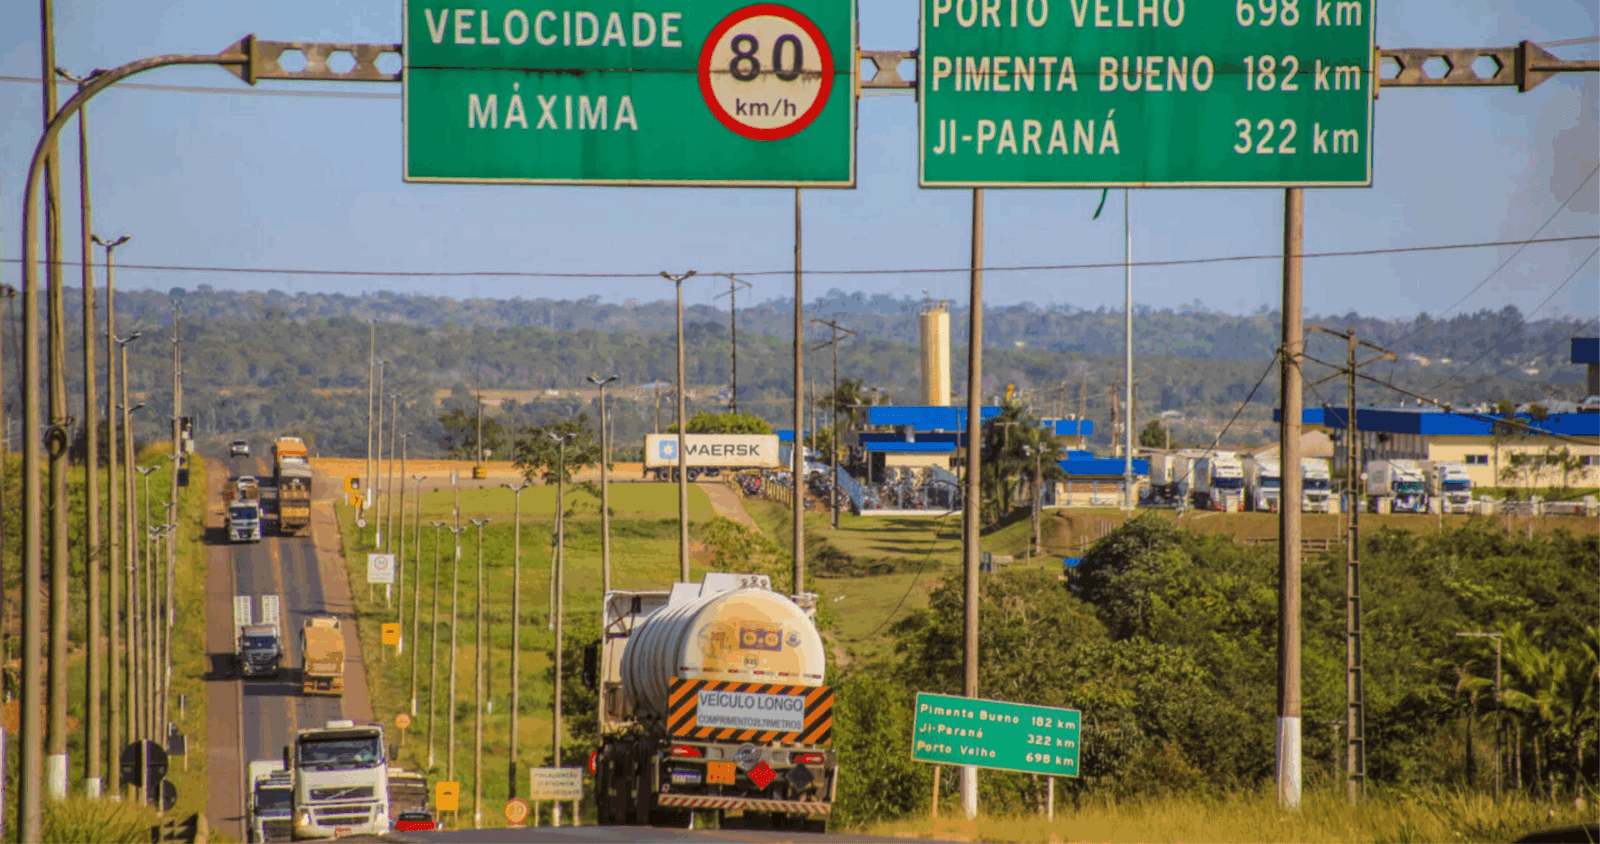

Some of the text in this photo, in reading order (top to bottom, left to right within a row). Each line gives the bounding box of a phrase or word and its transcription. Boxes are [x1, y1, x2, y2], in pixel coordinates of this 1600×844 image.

[932, 0, 1362, 28] PORTO VELHO 698 km
[424, 9, 682, 48] VELOCIDADE
[730, 33, 803, 82] 80
[932, 55, 1361, 92] PIMENTA BUENO 182 km
[468, 82, 639, 131] MÁXIMA
[735, 98, 797, 117] km/h
[932, 109, 1359, 155] JI-PARANÁ 322 km
[685, 444, 760, 456] MAERSK
[699, 689, 804, 712] VEÍCULO LONGO
[920, 703, 1076, 730] Pimenta Bueno 182 km
[917, 740, 1074, 767] Porto Velho 698 km
[1026, 734, 1052, 746] 322
[1056, 737, 1075, 748] km
